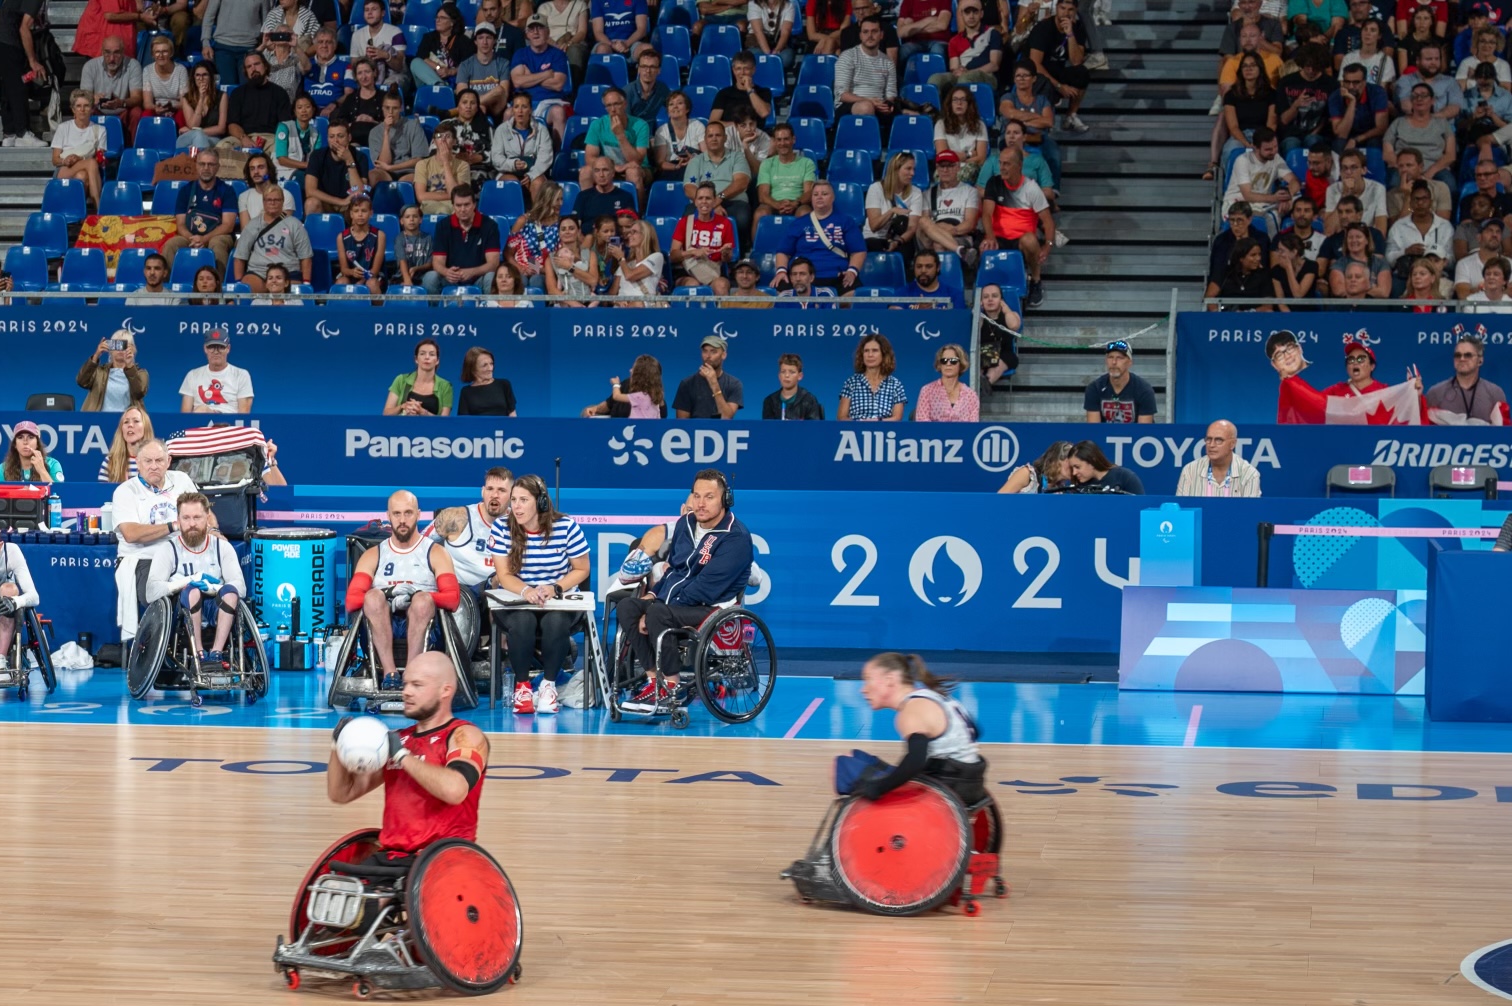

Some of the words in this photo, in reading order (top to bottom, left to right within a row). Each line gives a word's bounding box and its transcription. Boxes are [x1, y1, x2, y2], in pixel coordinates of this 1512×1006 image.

[256, 233, 286, 249] USA
[345, 429, 525, 460] Panasonic
[834, 431, 964, 463] Allianz
[1371, 440, 1512, 468] BRIDGES
[51, 557, 89, 567] PARIS
[182, 562, 194, 577] 11
[384, 562, 395, 577] 9
[128, 757, 786, 788] TOOTA
